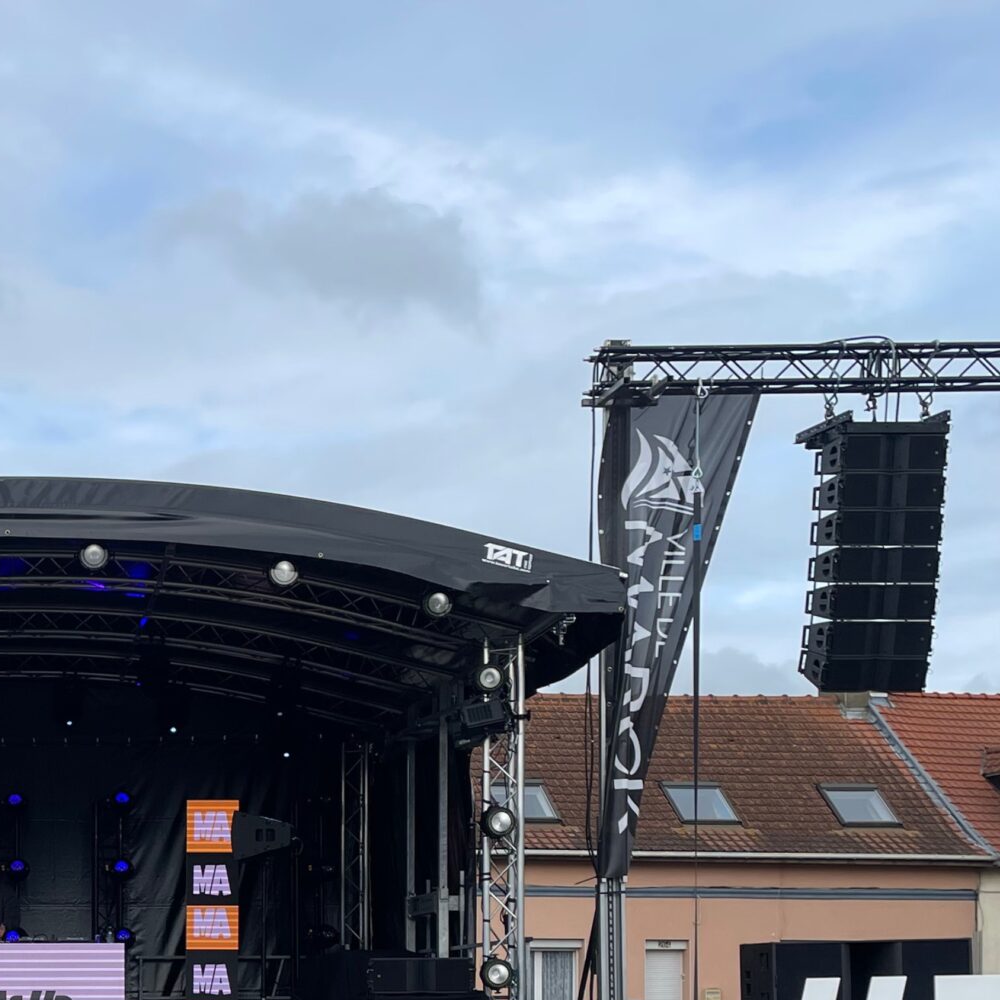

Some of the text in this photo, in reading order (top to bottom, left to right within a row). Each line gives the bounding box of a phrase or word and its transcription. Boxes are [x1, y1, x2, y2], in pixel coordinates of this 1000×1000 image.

[193, 811, 231, 842] MA
[193, 864, 232, 896] MA
[193, 907, 232, 939] MA
[193, 963, 232, 995] MA
